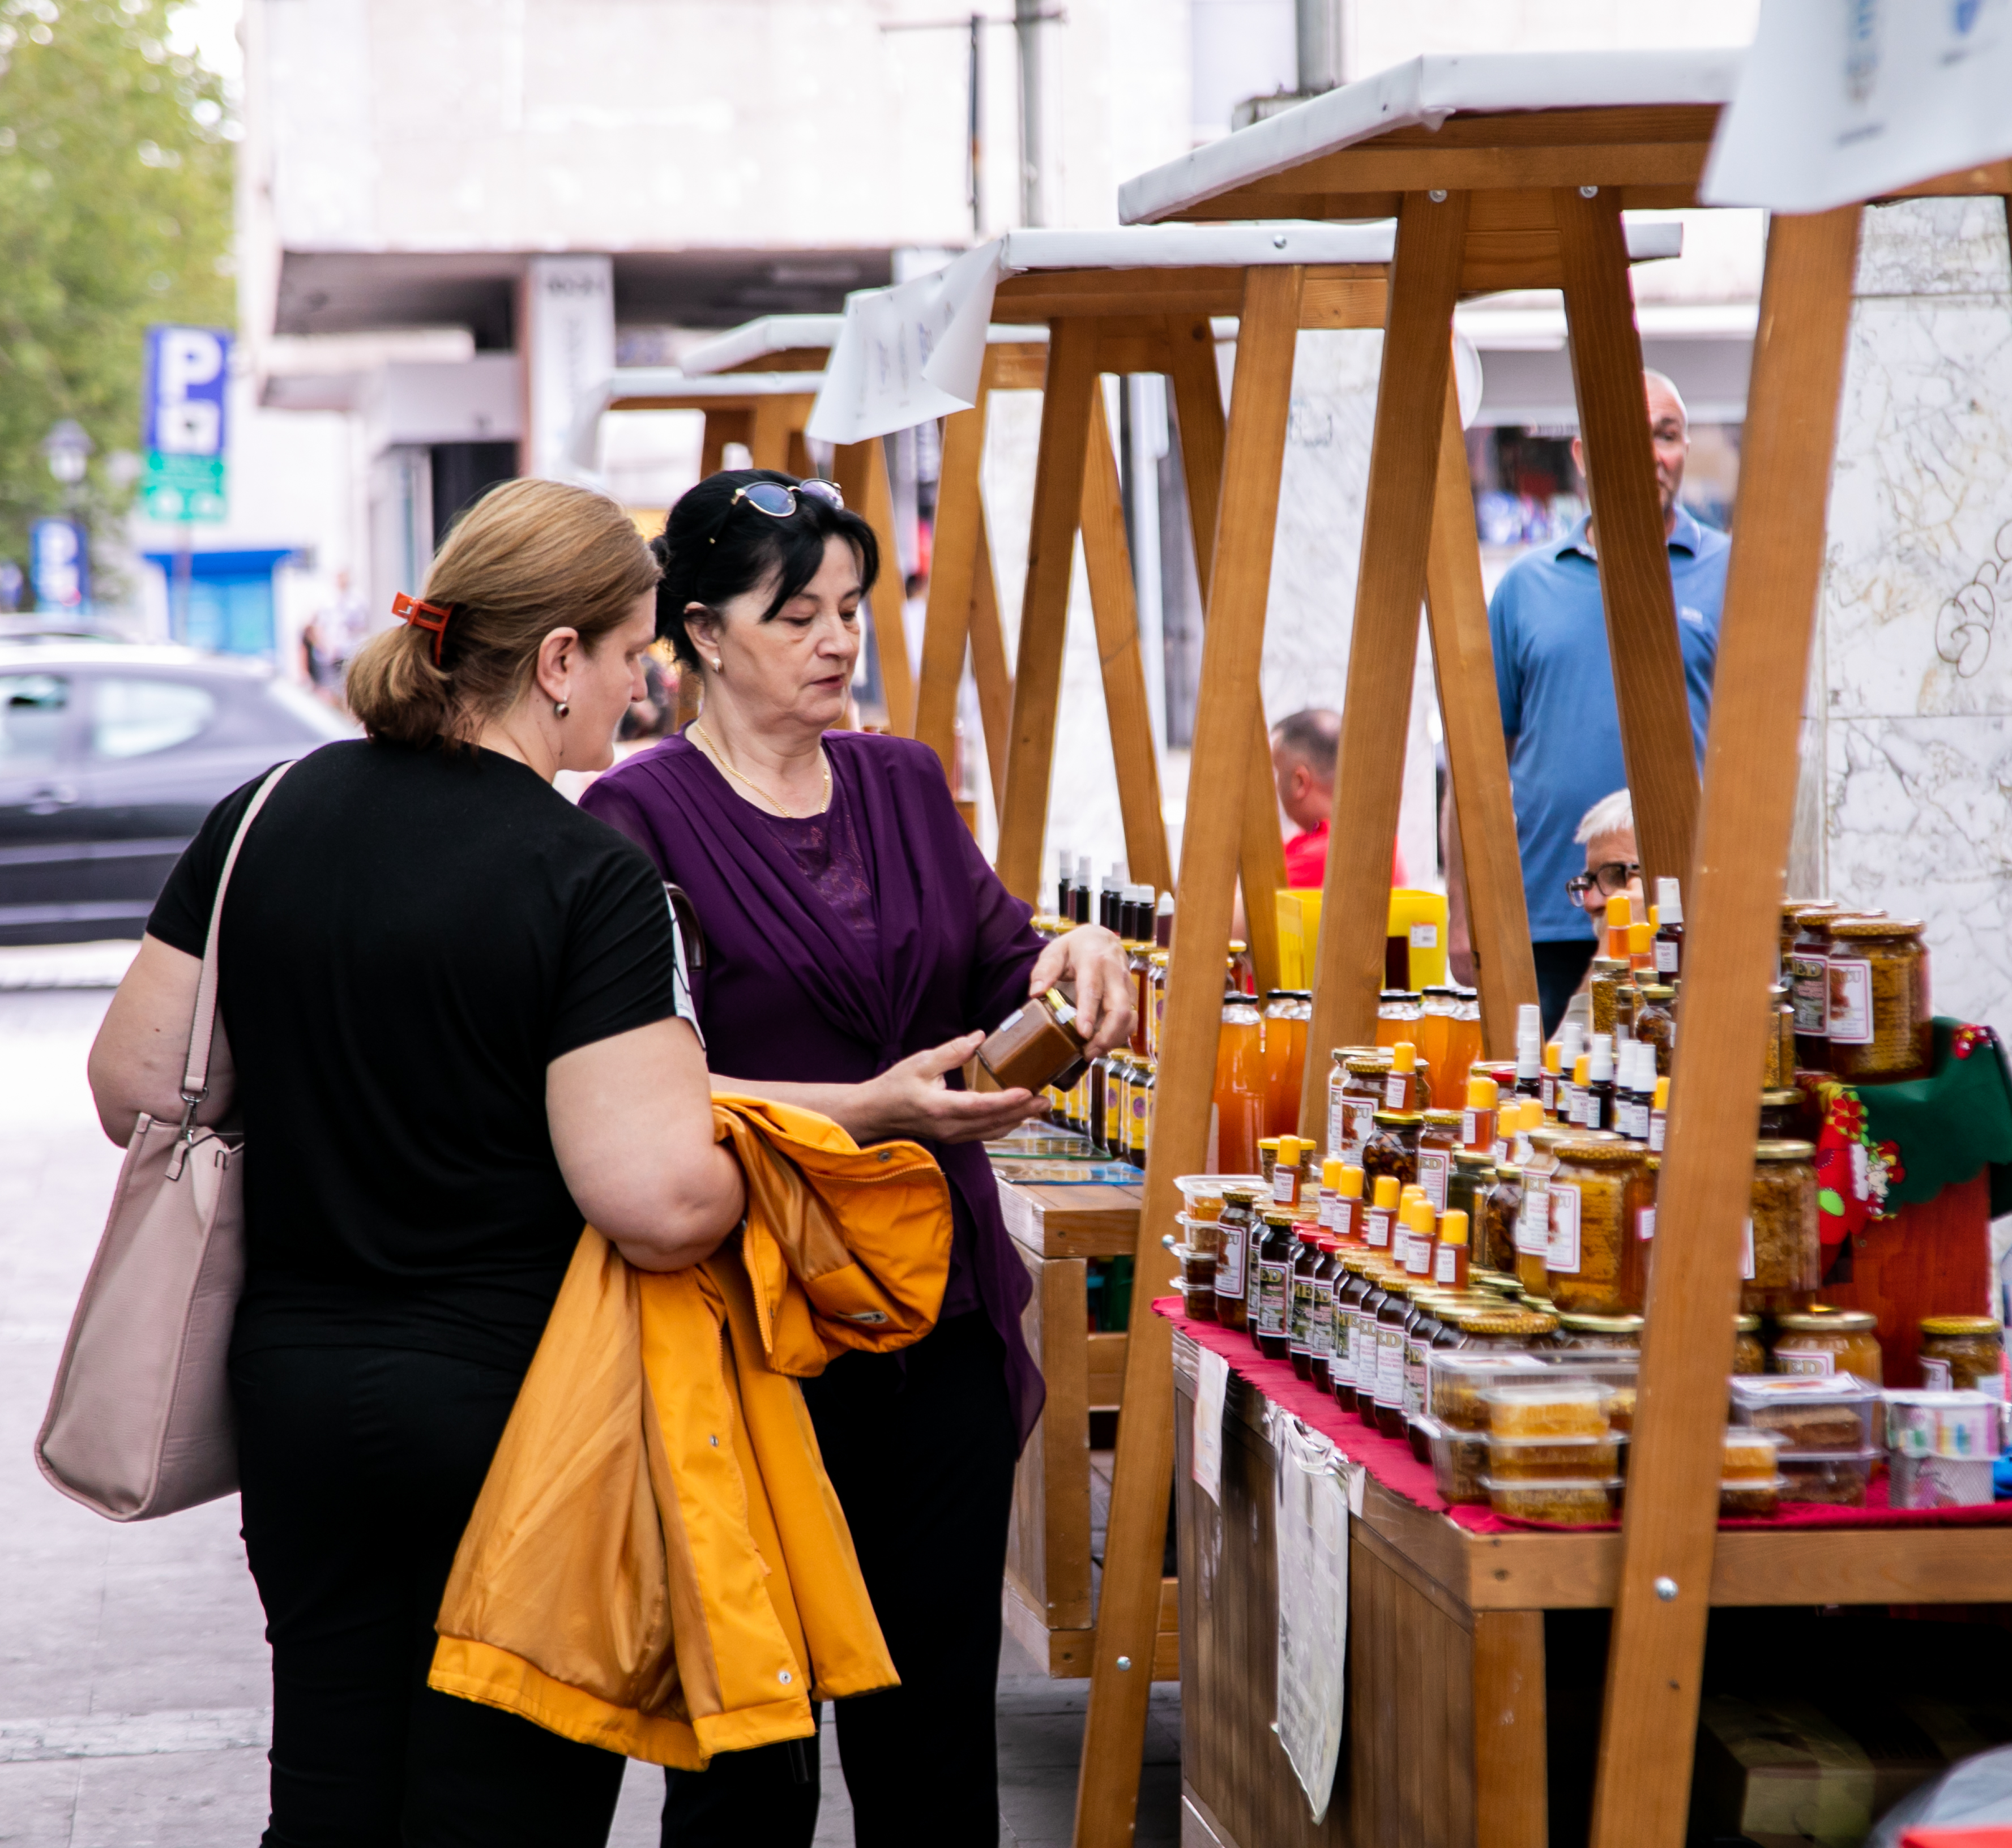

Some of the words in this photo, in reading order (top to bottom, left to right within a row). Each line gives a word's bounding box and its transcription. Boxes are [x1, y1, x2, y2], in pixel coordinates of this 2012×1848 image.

[159, 328, 223, 399] P
[1417, 1157, 1442, 1170] ED
[1523, 1175, 1549, 1194] ED
[1260, 1267, 1283, 1283] ED
[1314, 1287, 1331, 1303] ED
[1360, 1320, 1377, 1337] ED
[1377, 1330, 1402, 1348] ED
